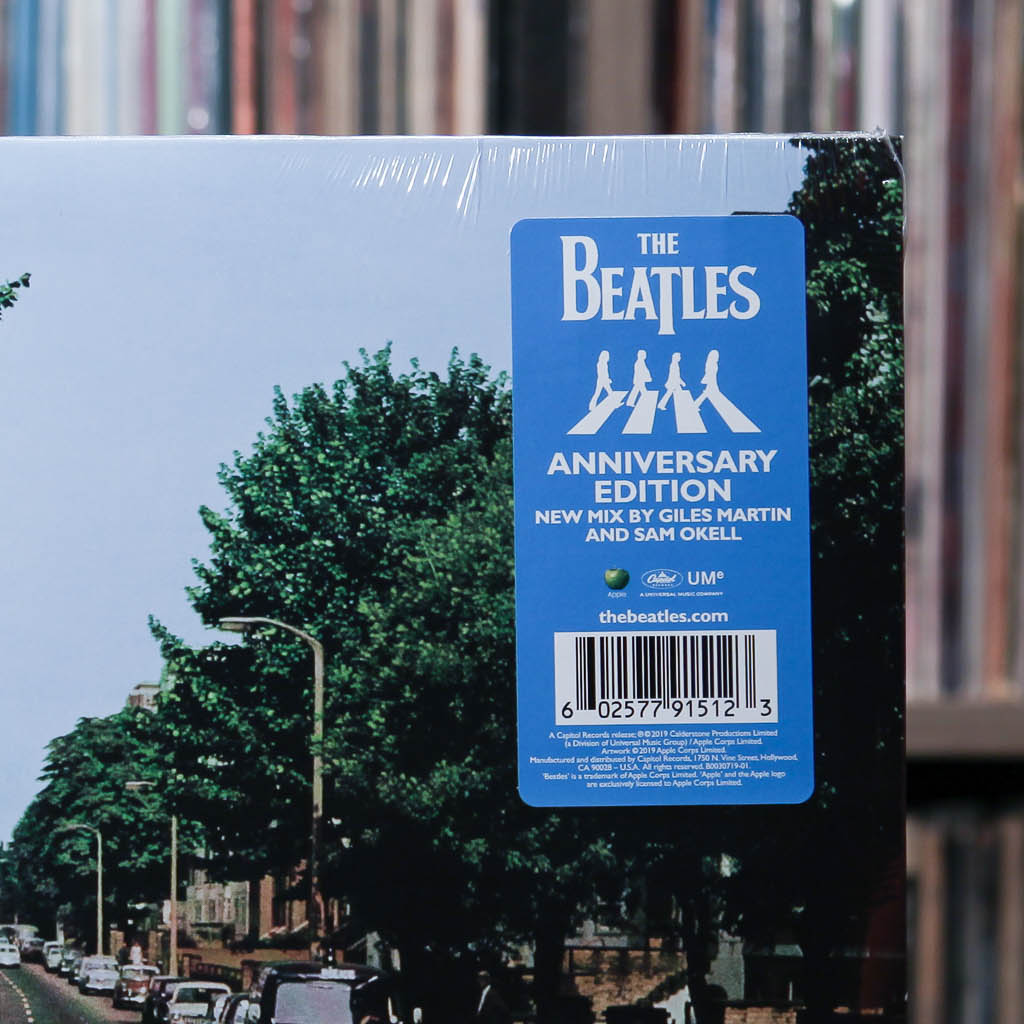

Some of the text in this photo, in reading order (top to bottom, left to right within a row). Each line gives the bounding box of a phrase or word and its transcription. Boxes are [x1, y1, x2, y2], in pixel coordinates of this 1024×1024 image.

[637, 233, 679, 254] THE
[547, 450, 778, 475] ANNIVERSARY
[595, 479, 732, 503] EDITION
[536, 508, 791, 524] NEW MIX BY GILES MARTIN
[585, 526, 742, 542] AND SAM OKELL
[599, 609, 728, 624] thebeatles.com
[562, 699, 772, 719] 6 02577 91512 3
[557, 731, 581, 741] Capitol
[712, 729, 752, 737] Productions
[643, 738, 662, 746] Music
[638, 755, 662, 764] Capitol
